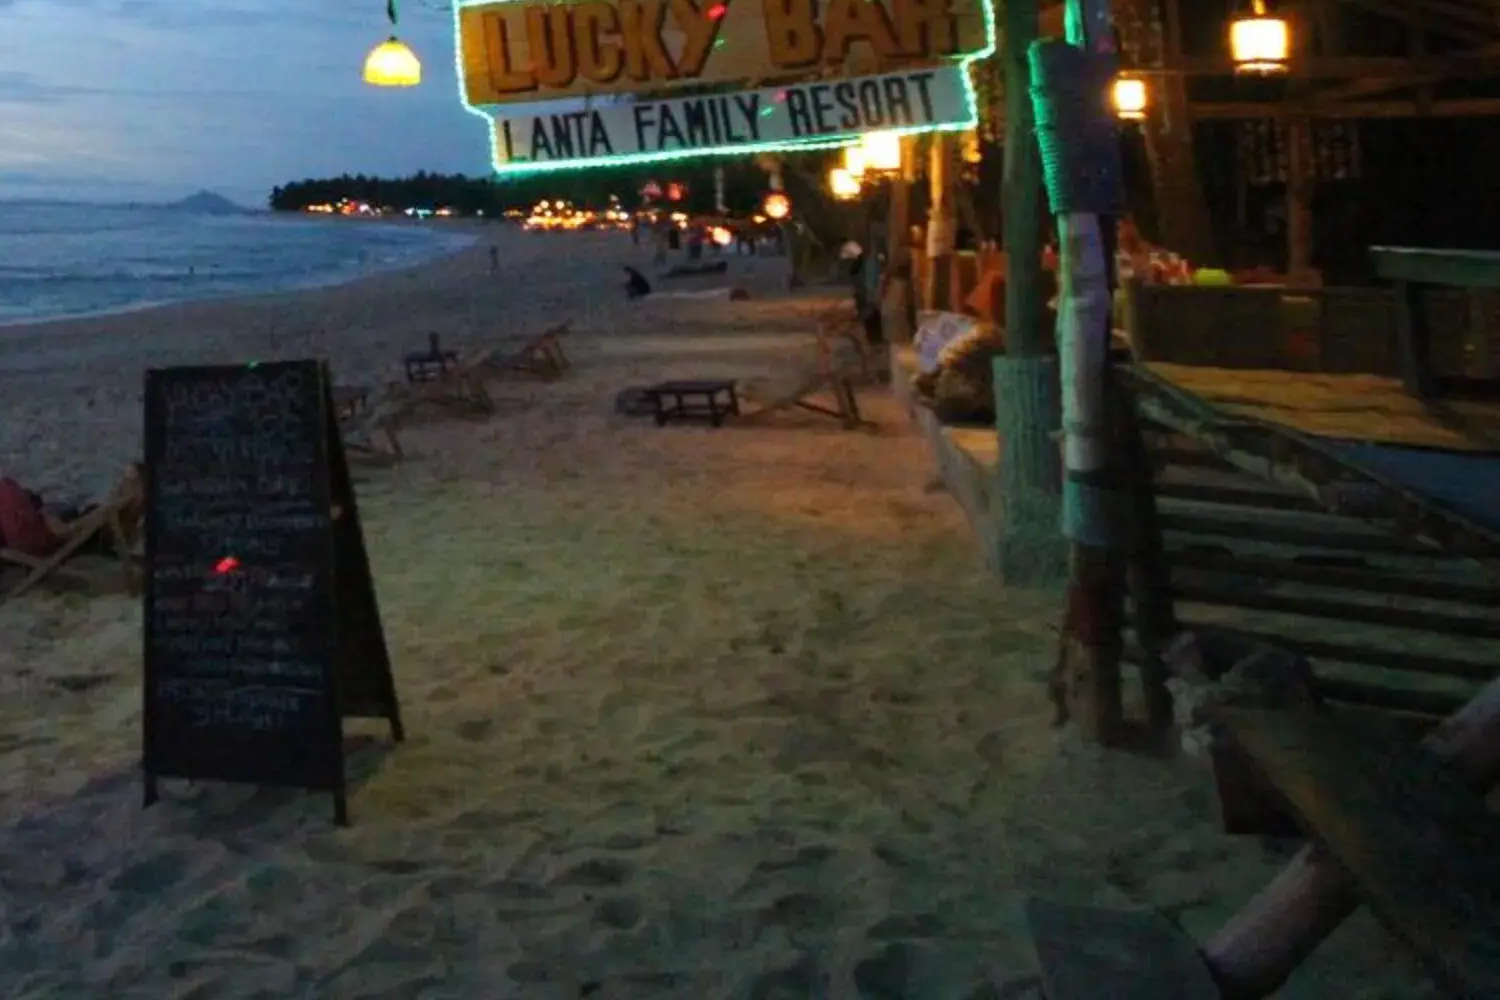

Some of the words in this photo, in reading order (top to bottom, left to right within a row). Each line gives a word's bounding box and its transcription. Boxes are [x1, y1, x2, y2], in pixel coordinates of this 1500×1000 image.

[503, 110, 610, 163] LANTA
[634, 93, 764, 153] FAMILY
[786, 73, 935, 137] RESORT
